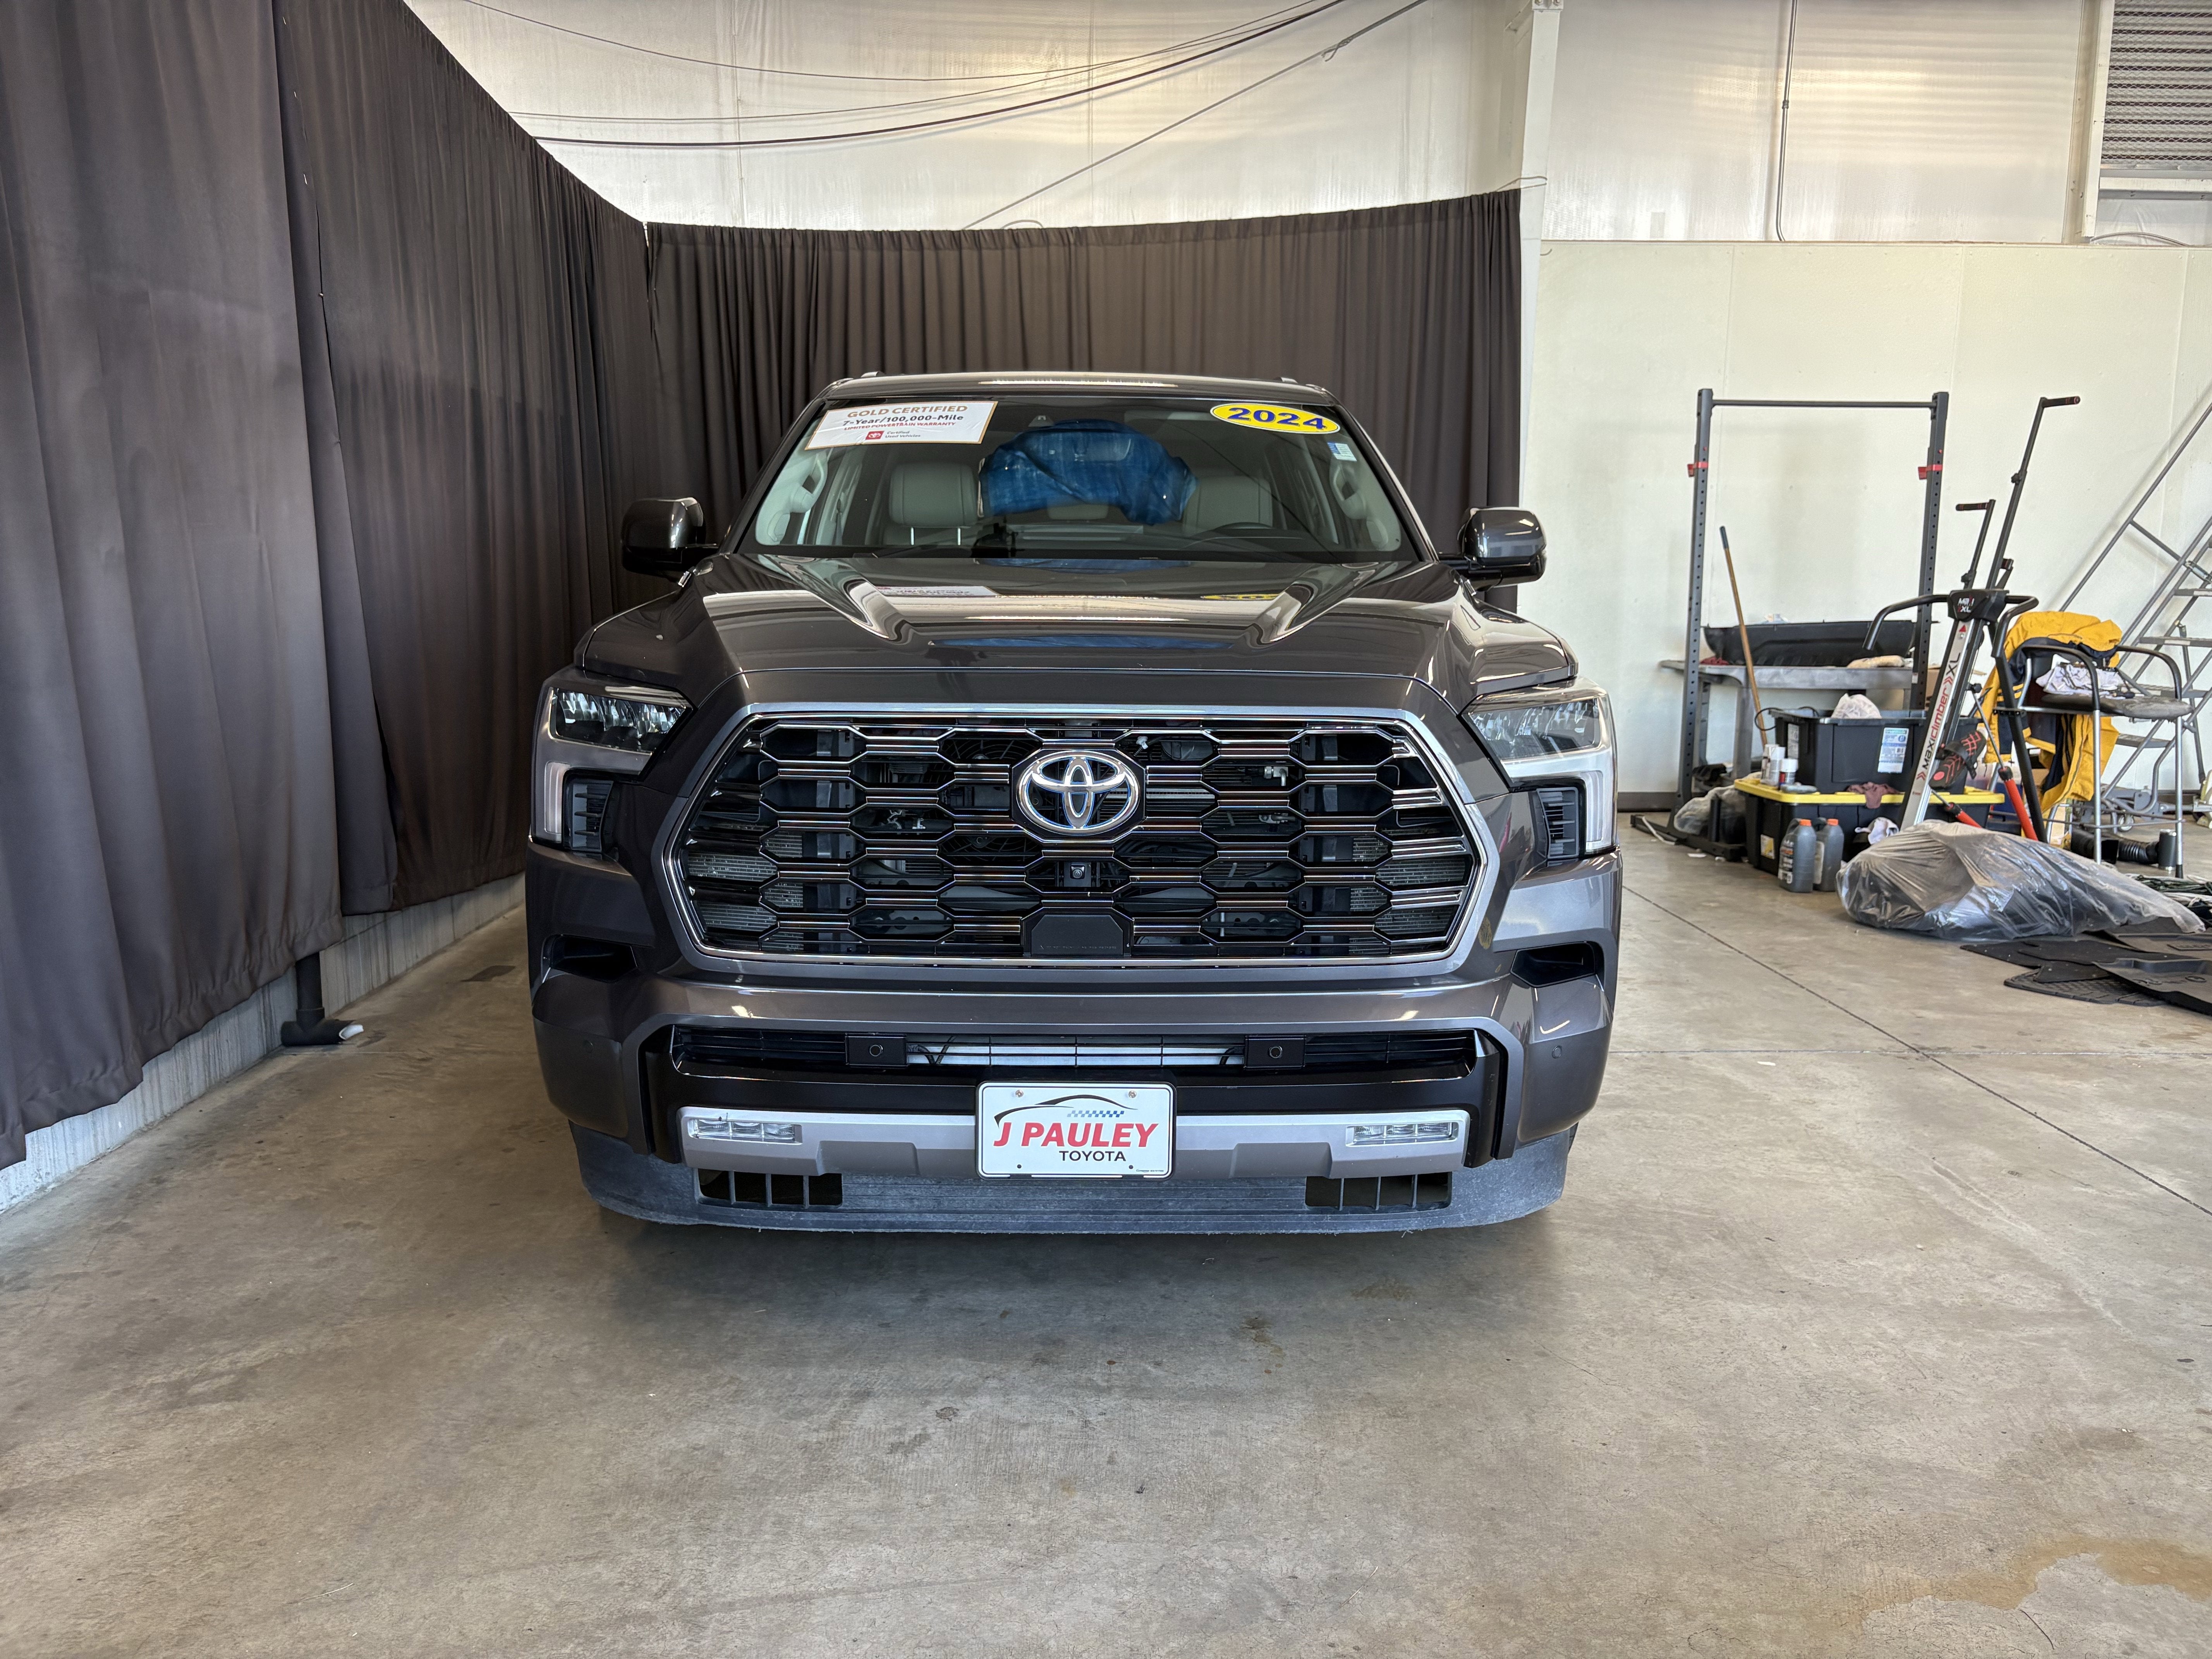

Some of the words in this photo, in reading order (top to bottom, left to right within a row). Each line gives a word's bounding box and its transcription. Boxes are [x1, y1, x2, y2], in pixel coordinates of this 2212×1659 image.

[843, 414, 963, 426] 7-Year/100,000-Mile
[847, 409, 889, 418] GOLD
[892, 405, 968, 414] CERTIFIED
[1227, 407, 1327, 429] 2024
[1946, 652, 1961, 675] XL
[993, 1122, 1012, 1147] J
[1021, 1122, 1159, 1147] PAULEY
[1059, 1151, 1127, 1161] TOYOTA
